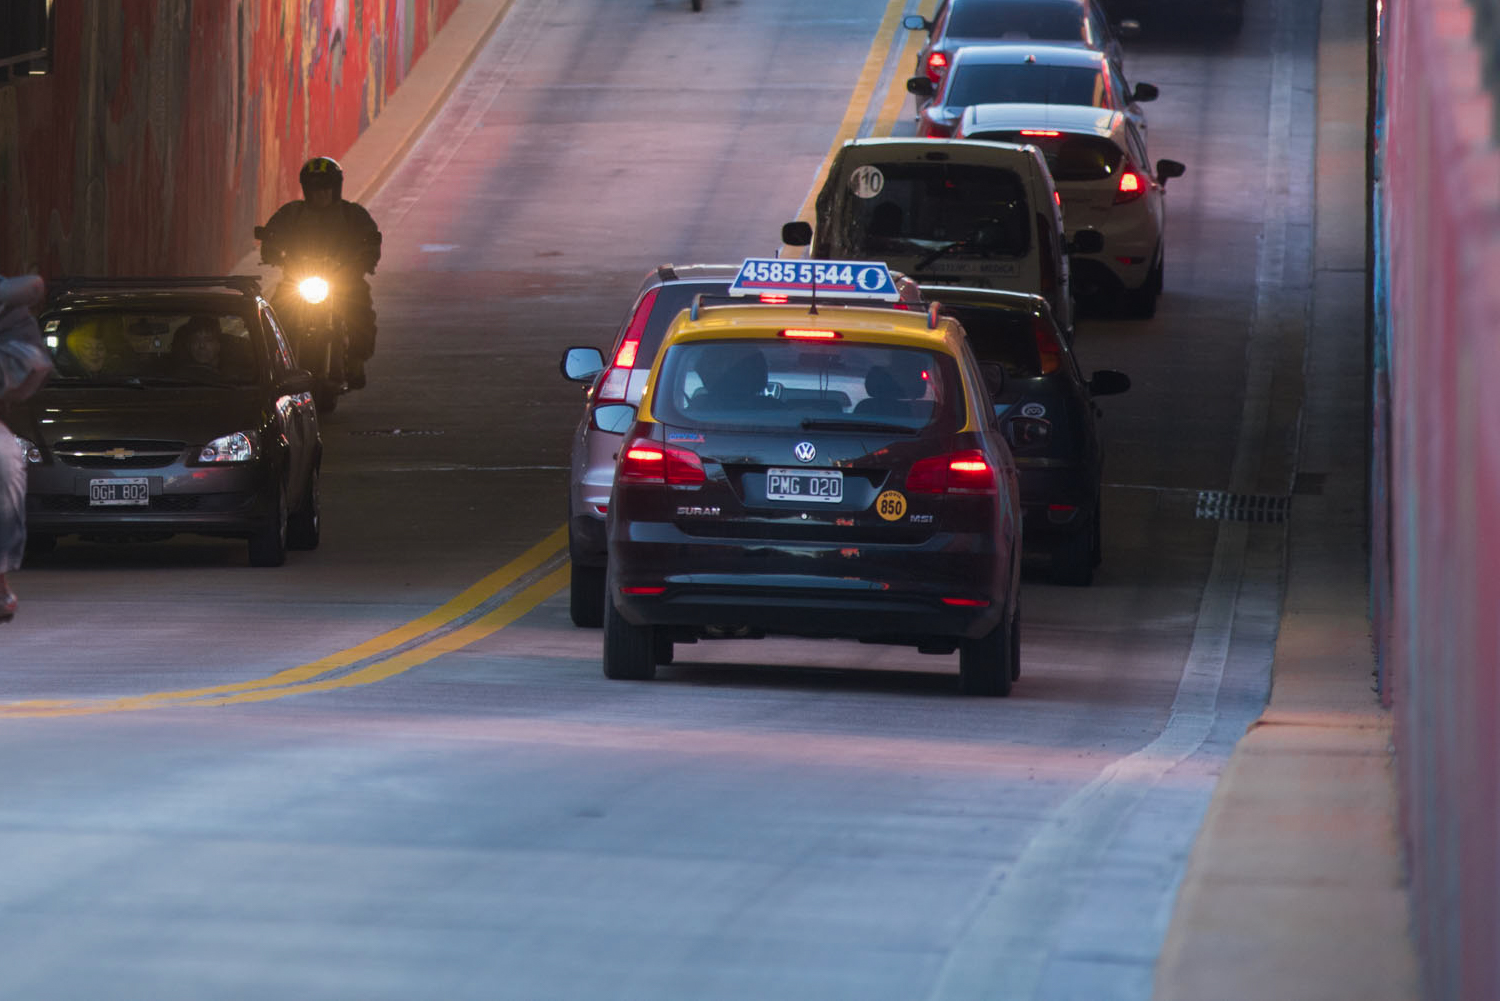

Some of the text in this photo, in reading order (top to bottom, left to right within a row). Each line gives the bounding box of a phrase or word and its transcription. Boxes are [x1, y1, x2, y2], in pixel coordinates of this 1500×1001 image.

[743, 262, 796, 283] 4585
[800, 264, 853, 285] 5544
[93, 485, 146, 500] OGH 802
[770, 476, 839, 497] PMG 020
[677, 507, 721, 516] SURAN
[881, 499, 903, 515] 850
